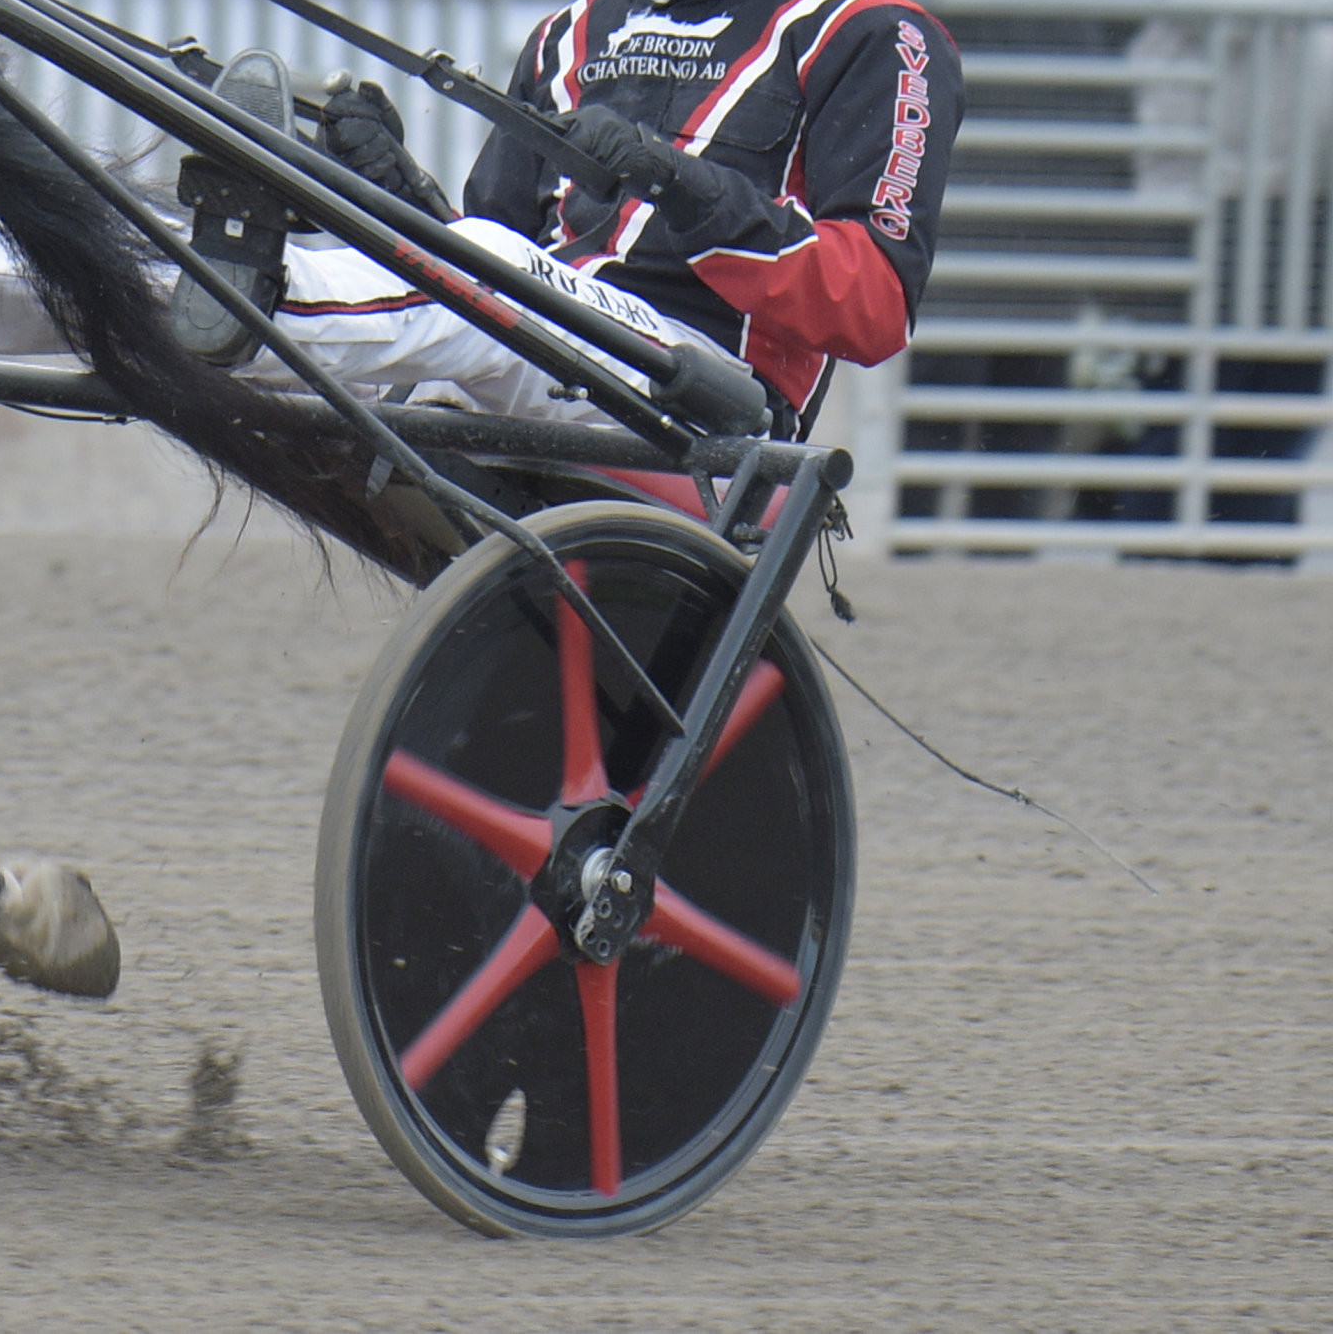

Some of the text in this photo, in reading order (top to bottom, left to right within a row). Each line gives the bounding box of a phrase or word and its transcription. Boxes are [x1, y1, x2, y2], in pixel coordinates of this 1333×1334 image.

[642, 37, 716, 59] BRODIN
[576, 55, 727, 86] (CHARTERING) AB
[869, 20, 931, 241] SVEDBERG
